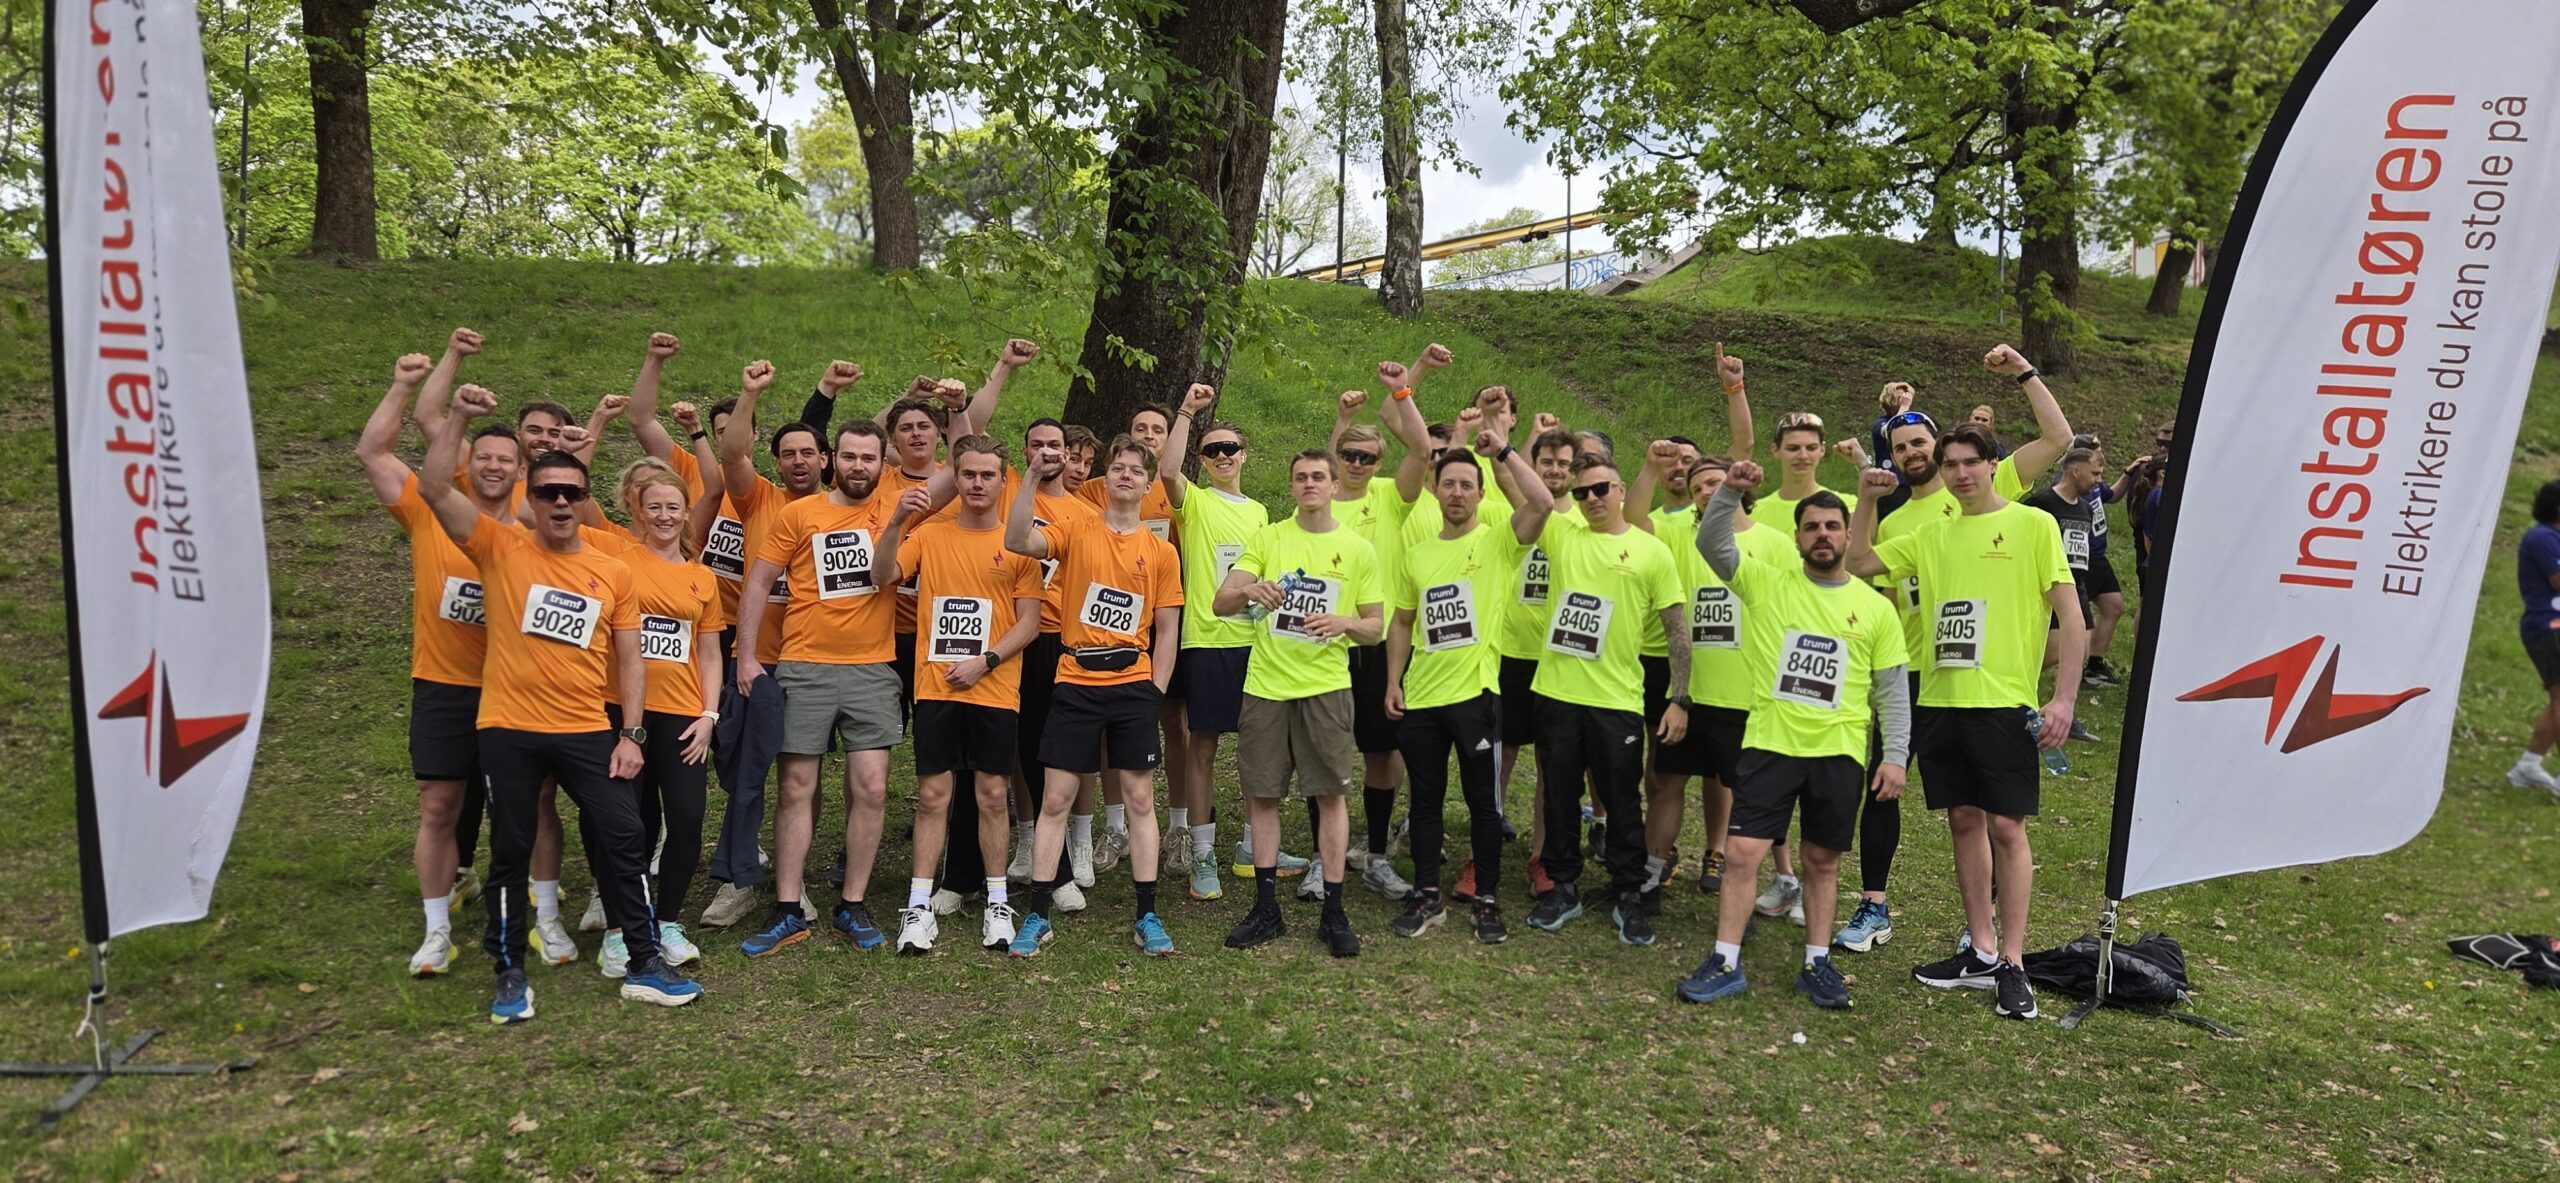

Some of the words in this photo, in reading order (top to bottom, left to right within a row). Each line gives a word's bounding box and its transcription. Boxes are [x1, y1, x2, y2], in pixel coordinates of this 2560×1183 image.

[2481, 96, 2528, 142] på
[2461, 155, 2514, 251] stole
[2436, 263, 2490, 331] kan
[2279, 95, 2455, 588] Installatøren
[2427, 343, 2471, 389] du
[2382, 401, 2457, 597] Elektrikere
[723, 523, 744, 534] trum
[830, 535, 856, 545] trumf
[823, 548, 868, 571] 9028
[1527, 563, 1550, 581] 84
[465, 586, 484, 597] tru
[837, 580, 863, 589] ENERGI
[1299, 582, 1322, 592] rumf
[1430, 587, 1454, 600] trumf
[1701, 590, 1724, 598] trumf
[550, 594, 583, 610] trumf
[948, 602, 975, 611] trumf
[1103, 591, 1130, 605] trumf
[1282, 592, 1328, 614] 8405
[1572, 597, 1597, 608] trumf
[448, 600, 486, 625] 902
[1088, 603, 1133, 631] 9028
[1426, 600, 1467, 625] 8405
[1694, 604, 1733, 623] 8405
[1945, 604, 1969, 614] trumf
[532, 607, 586, 639] 9028
[648, 620, 676, 631] trumf
[939, 616, 982, 636] 9028
[1559, 608, 1601, 633] 8405
[1936, 619, 1975, 641] 8405
[640, 634, 682, 658] 9028
[1803, 638, 1833, 651] trumf
[1787, 651, 1839, 680] 8405
[1792, 686, 1822, 697] ENERGI
